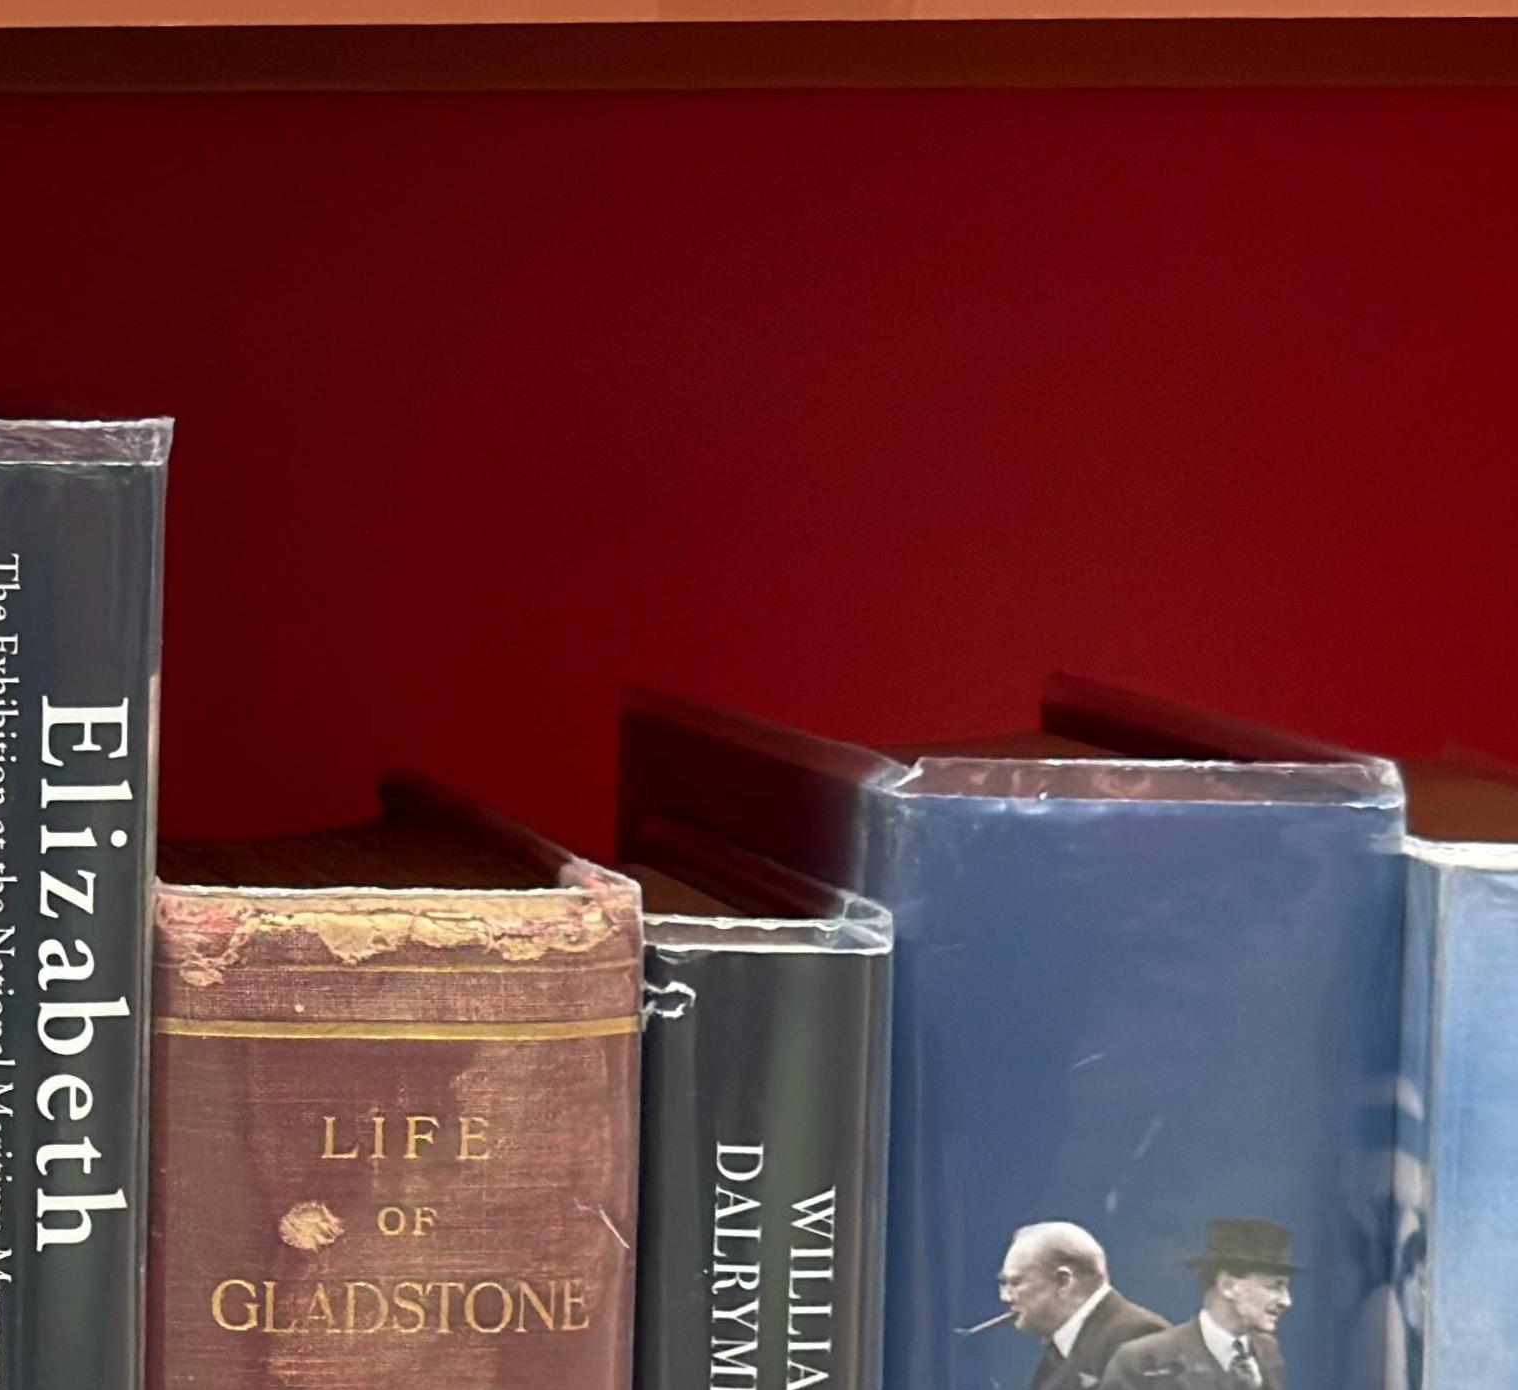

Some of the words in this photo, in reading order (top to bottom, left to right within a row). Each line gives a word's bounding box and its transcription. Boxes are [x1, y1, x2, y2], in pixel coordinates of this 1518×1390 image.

[36, 695, 134, 1251] Elizabeth
[321, 1116, 493, 1161] LIFE
[377, 1206, 437, 1236] OF
[211, 1279, 590, 1334] GLADSTONE
